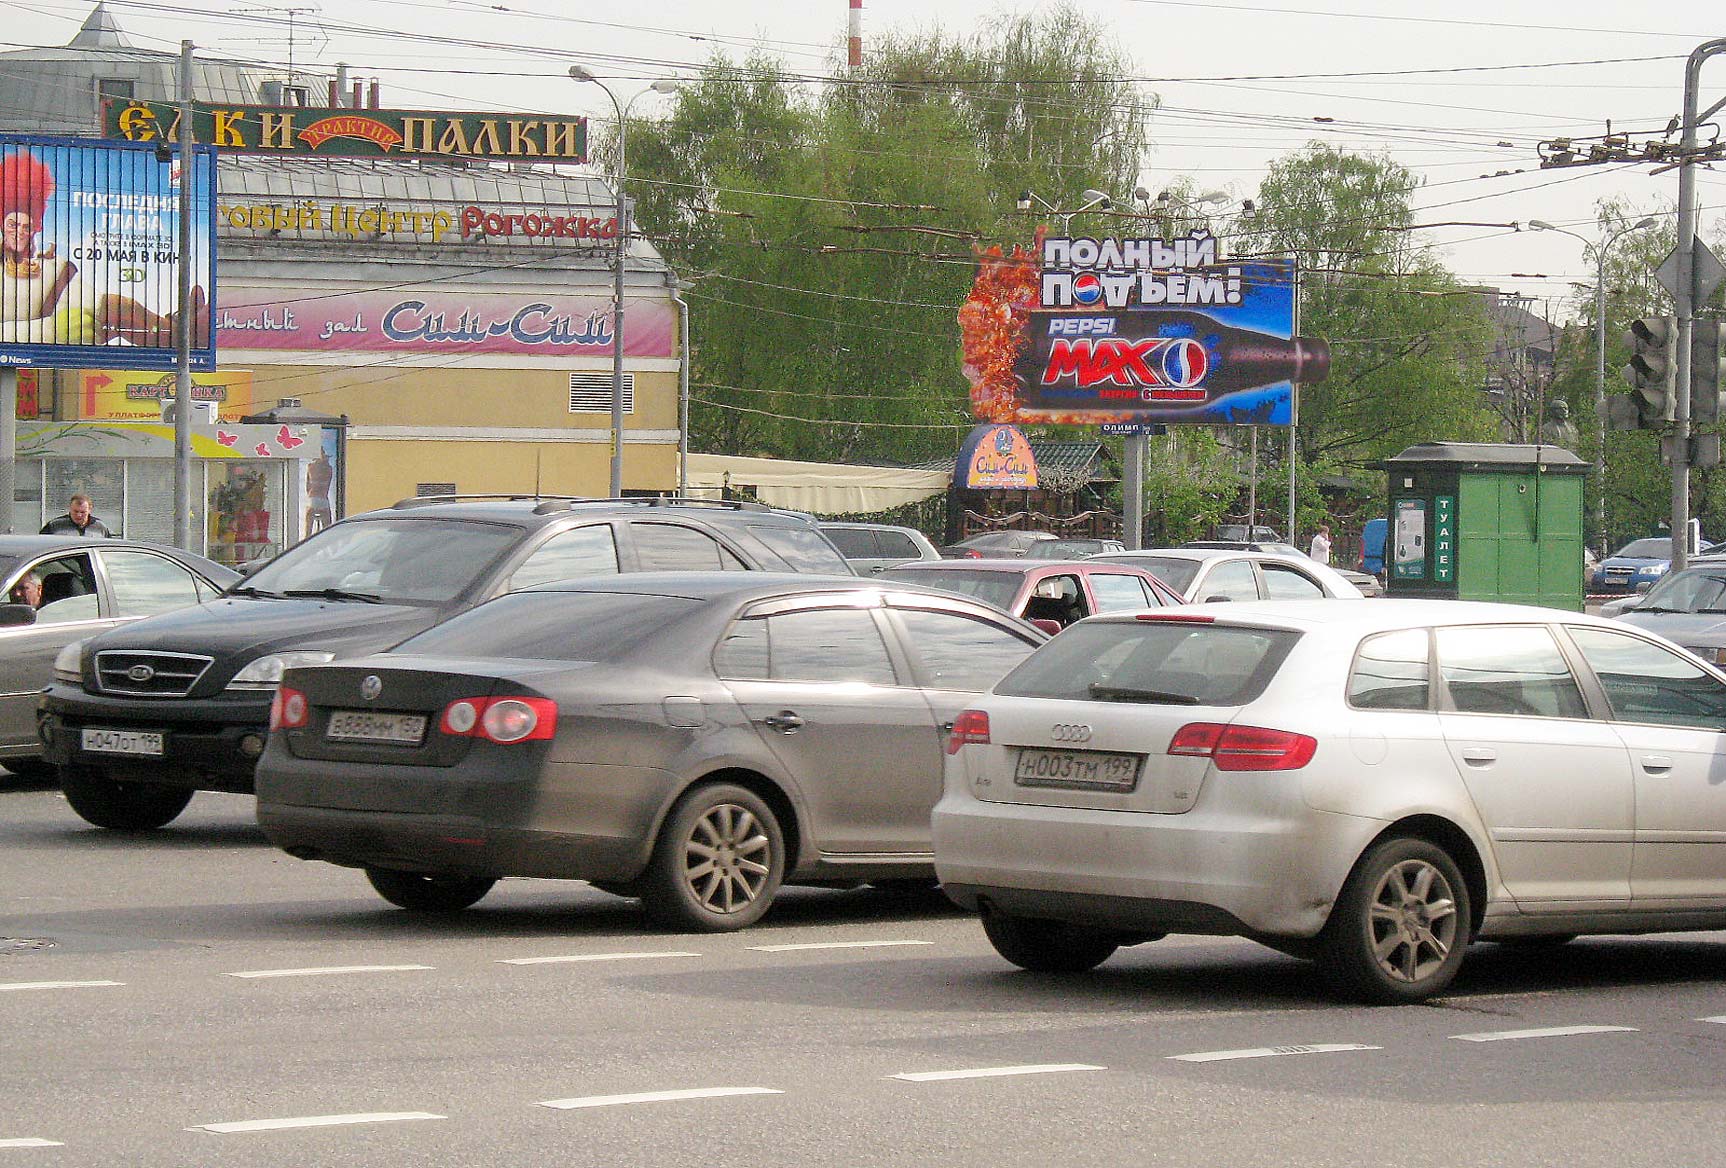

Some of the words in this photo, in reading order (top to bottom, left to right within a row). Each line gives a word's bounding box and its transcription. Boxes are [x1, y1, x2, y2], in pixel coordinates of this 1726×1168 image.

[307, 119, 394, 146] ТРАКТИР
[400, 117, 579, 157] ПАЛКИ
[73, 191, 180, 214] ПОСЛЕДНЯ
[101, 213, 164, 231] ГЛАВА
[73, 247, 82, 259] С
[86, 248, 102, 260] 20
[108, 249, 136, 262] МАЯ
[141, 251, 149, 263] В
[153, 251, 191, 264] КИН
[1044, 231, 1214, 268] ПОЛНЫЙ
[319, 313, 367, 338] зал
[1049, 318, 1116, 335] PEPSI
[8, 355, 32, 364] News
[1041, 337, 1172, 388] MAX
[1103, 424, 1139, 432] ОЛИМП
[1439, 500, 1450, 578] ТУАЛЕТ
